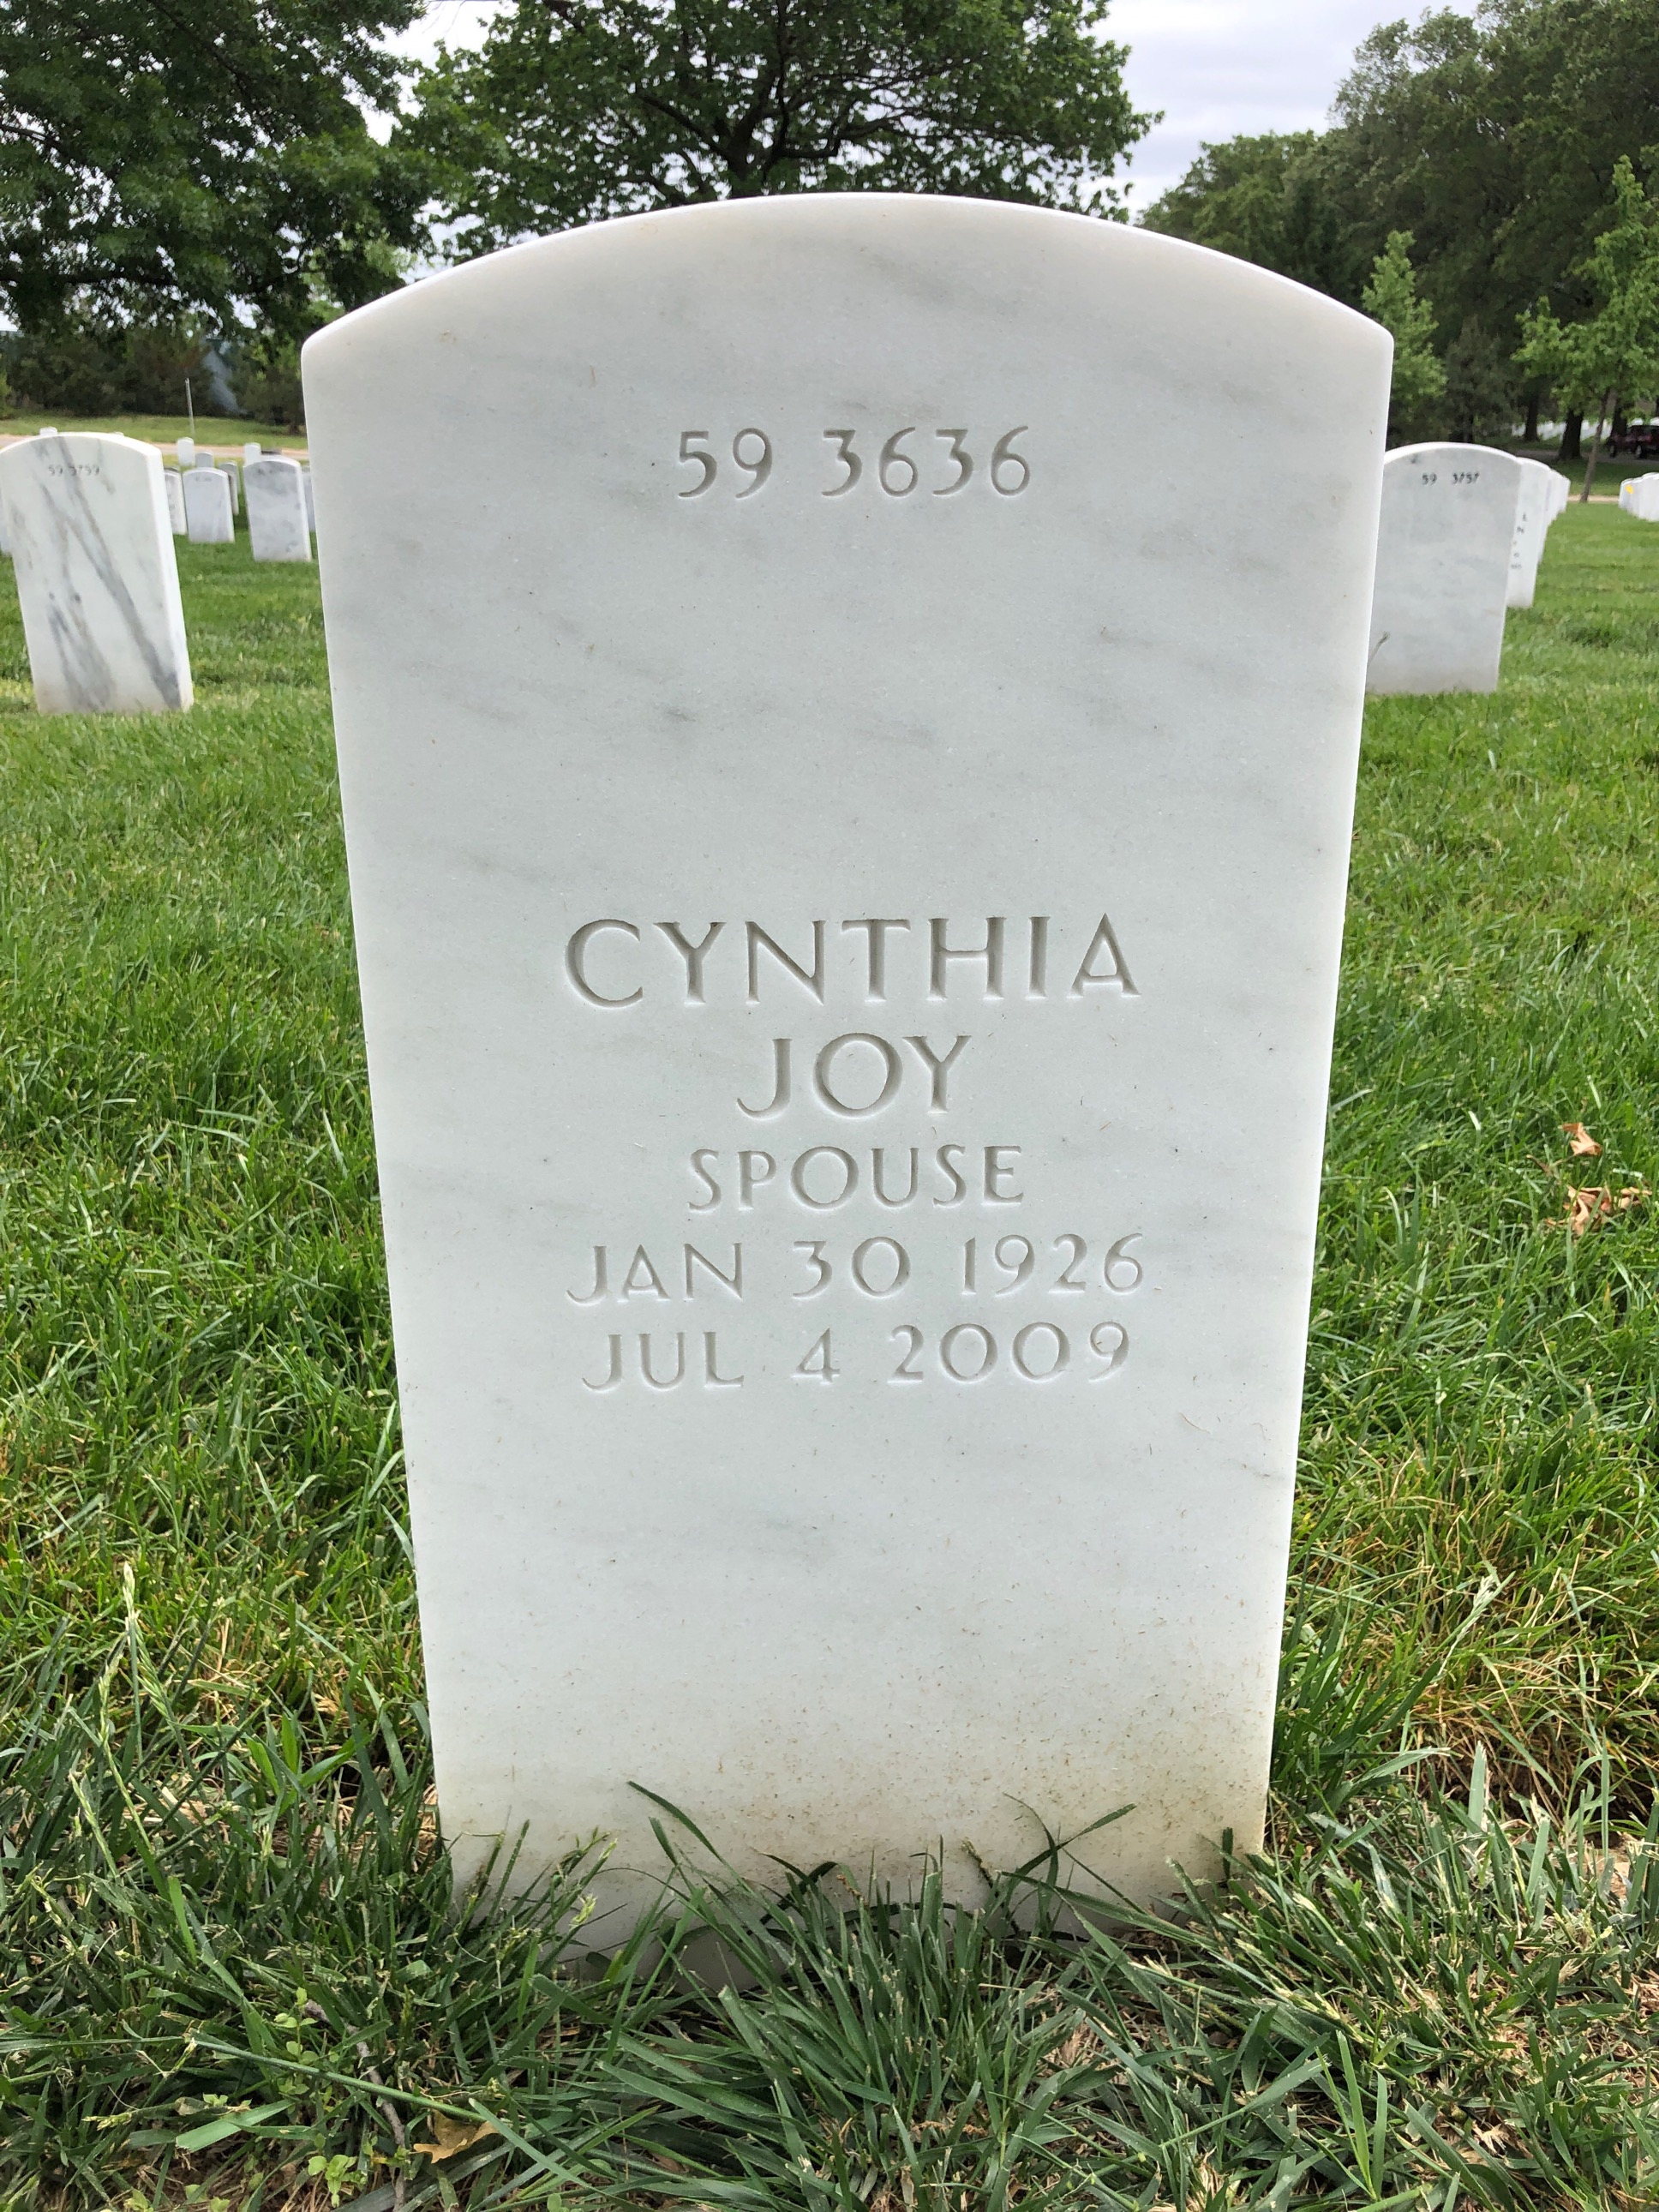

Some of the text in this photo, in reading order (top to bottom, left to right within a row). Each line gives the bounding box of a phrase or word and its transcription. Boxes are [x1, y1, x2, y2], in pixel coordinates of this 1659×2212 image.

[678, 426, 1031, 500] 59 3636
[565, 912, 1141, 1008] CYNTHIA
[736, 1032, 972, 1118] JOY
[687, 1144, 1025, 1212] SPOUSE
[566, 1232, 1144, 1306] JAN 30 1926
[582, 1320, 1130, 1391] JUL 4 2009
